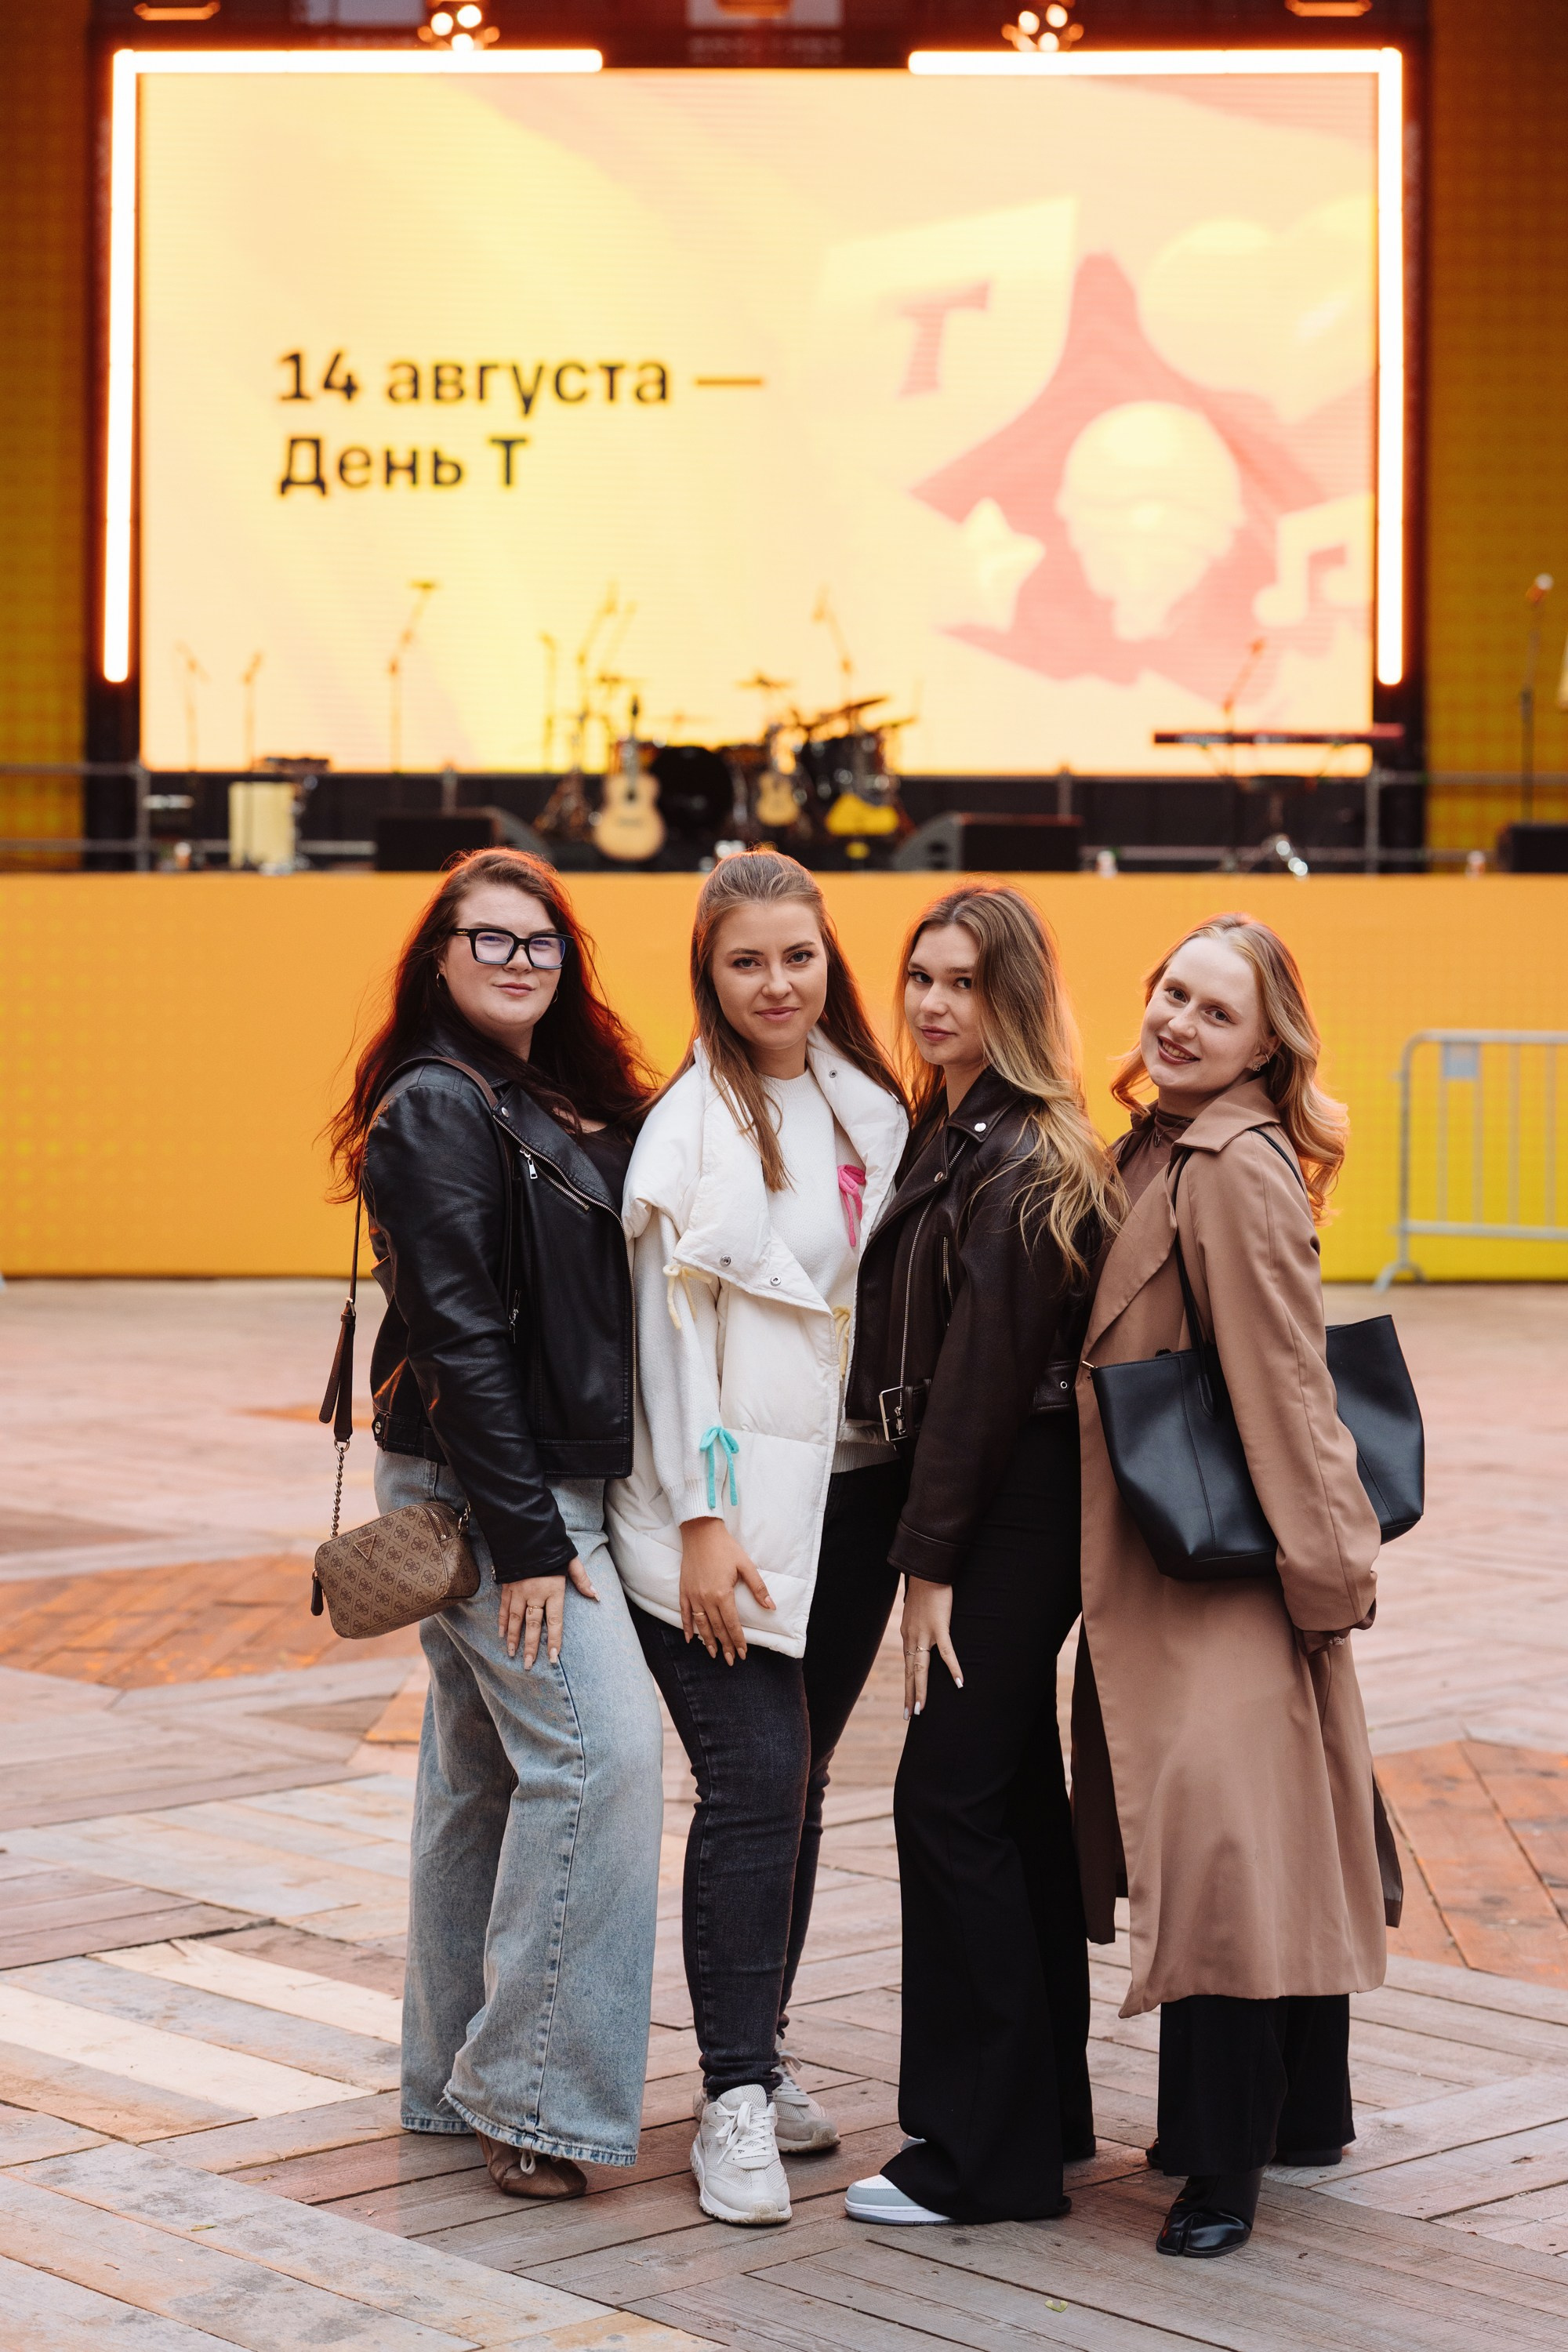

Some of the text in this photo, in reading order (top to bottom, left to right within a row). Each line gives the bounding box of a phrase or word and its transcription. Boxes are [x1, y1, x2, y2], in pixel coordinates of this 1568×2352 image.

[280, 350, 360, 402] 14
[387, 362, 669, 417] августа
[278, 435, 528, 498] День Т
